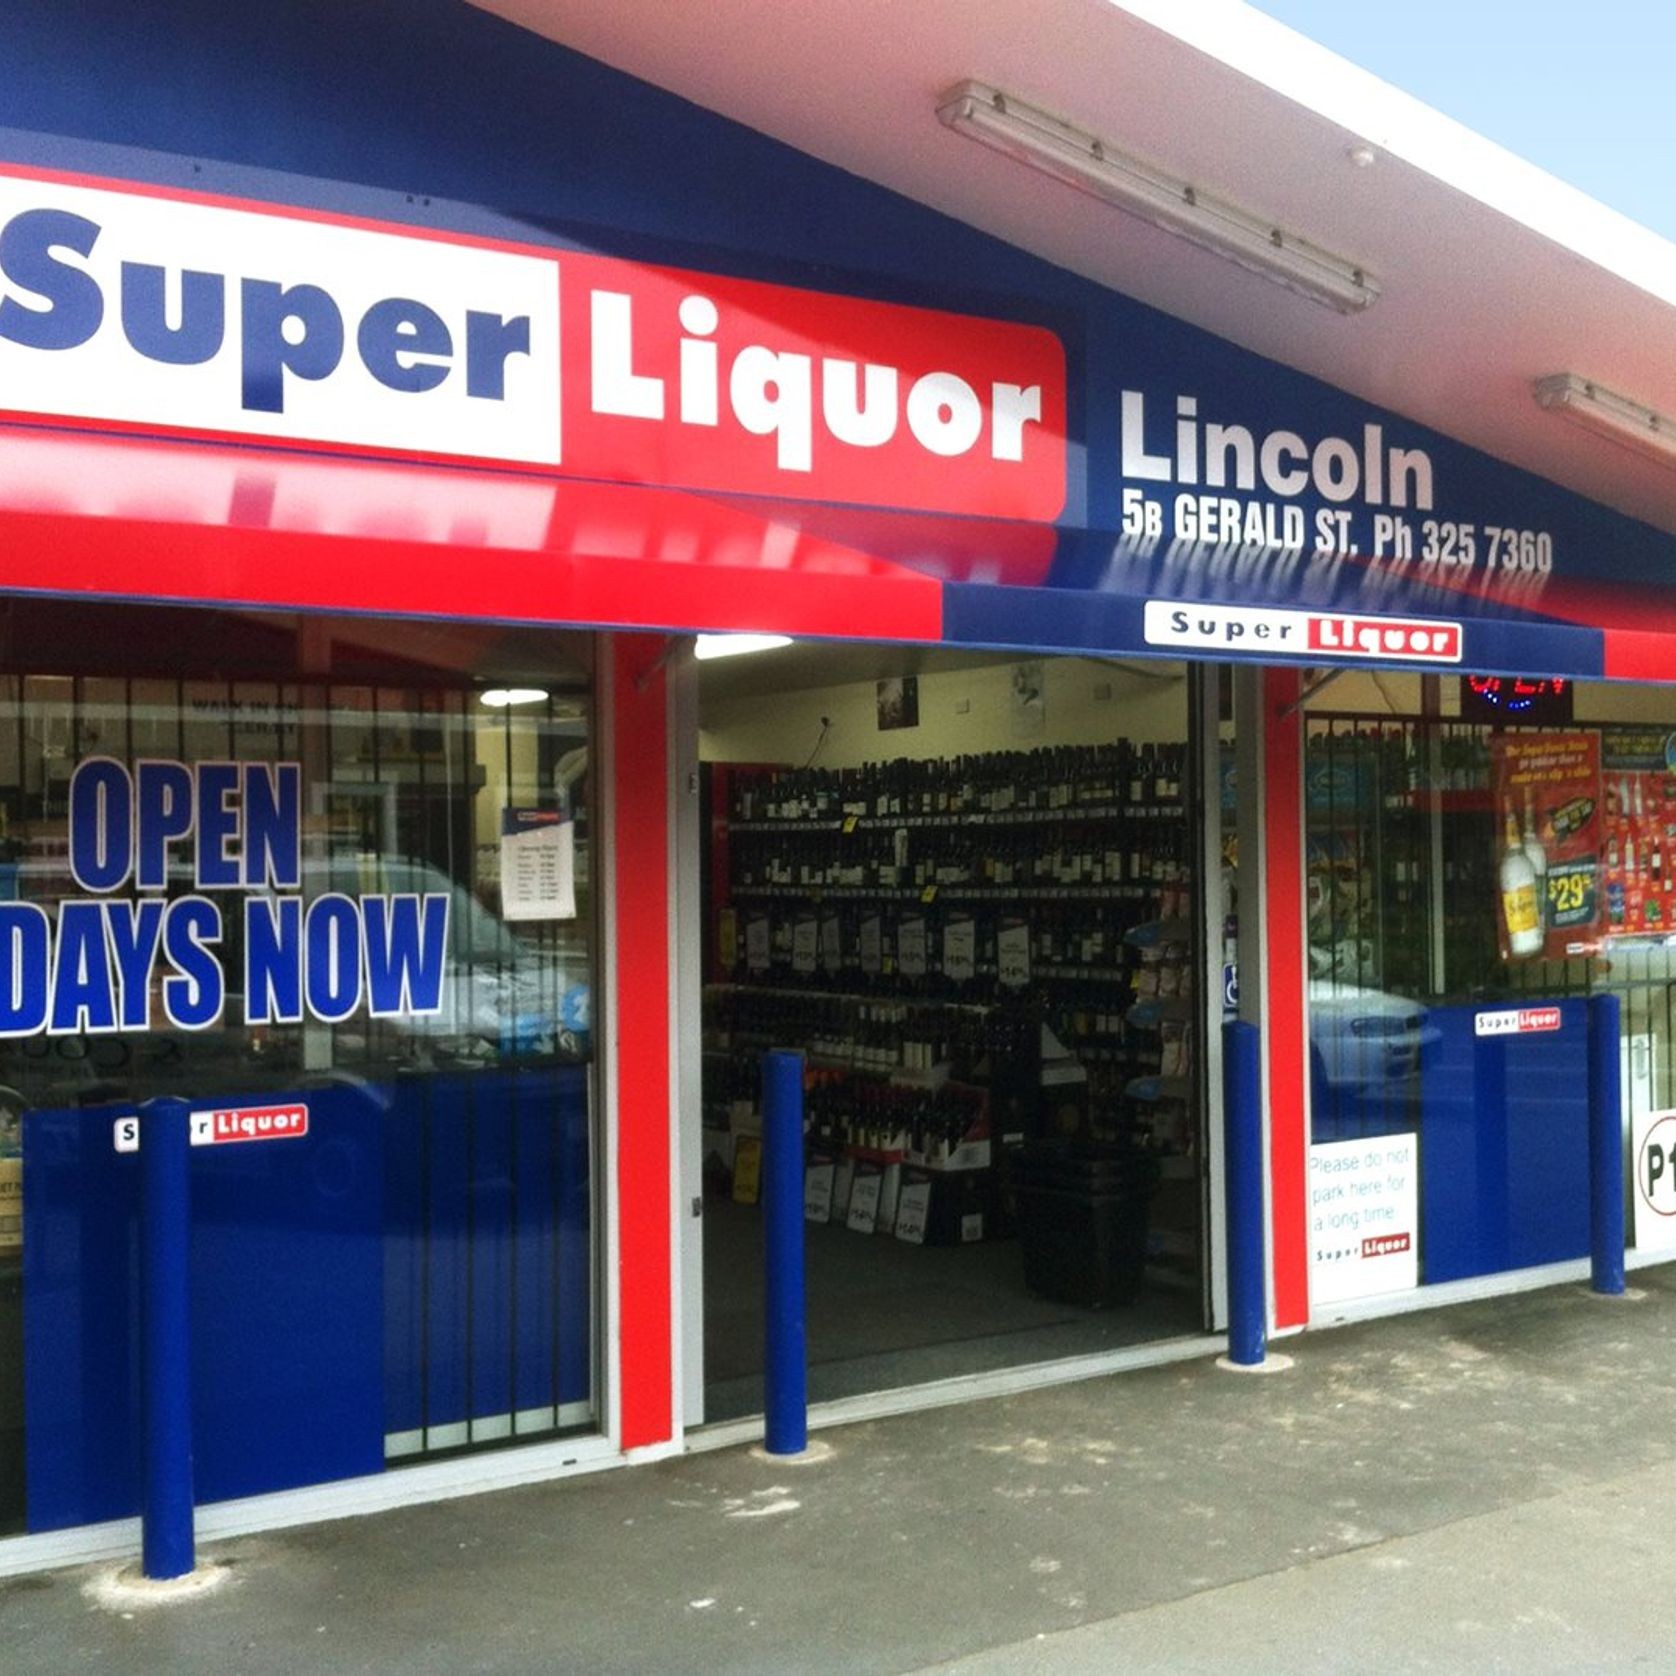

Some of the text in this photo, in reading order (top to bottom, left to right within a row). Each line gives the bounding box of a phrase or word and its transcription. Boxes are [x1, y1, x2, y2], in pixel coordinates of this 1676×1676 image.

[0, 208, 1041, 472] Super Liquor
[1121, 390, 1433, 510] Lincoln
[1122, 488, 1552, 572] 5B GERALD ST. Ph 325 7360
[1171, 609, 1449, 652] Super Liquor
[69, 757, 301, 893] OPEN
[0, 892, 451, 1038] DAYS NOW
[1479, 1012, 1557, 1030] Super Liquor
[217, 1112, 301, 1135] Liquor
[1310, 1156, 1359, 1173] Please
[1364, 1150, 1381, 1167] do
[1312, 1184, 1344, 1207] park
[1314, 1217, 1323, 1231] a
[1317, 1238, 1408, 1261] Super Liquor
